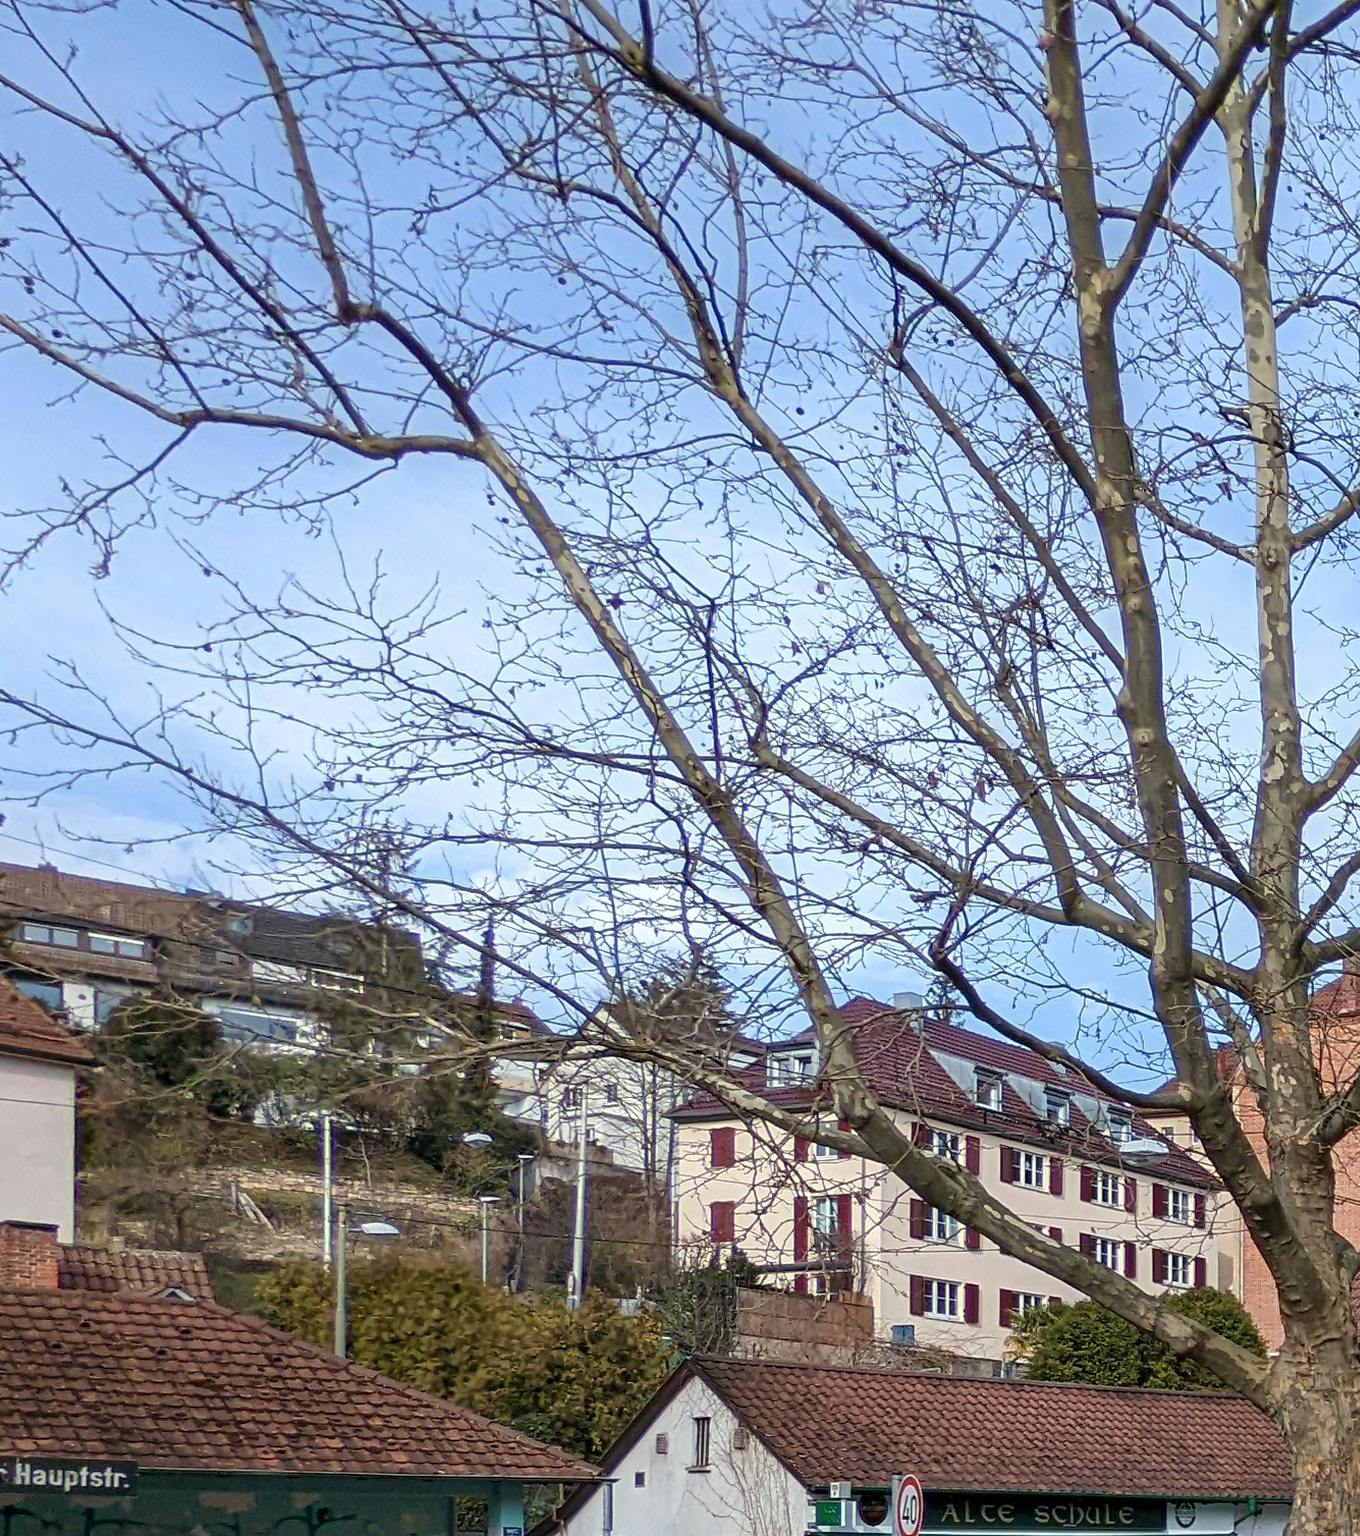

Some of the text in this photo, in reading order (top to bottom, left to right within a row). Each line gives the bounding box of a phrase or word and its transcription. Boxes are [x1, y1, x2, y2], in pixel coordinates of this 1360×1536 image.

[15, 1462, 130, 1492] Hauptstr.
[902, 1494, 918, 1525] 40
[940, 1501, 1135, 1526] ALTE SCHULE
